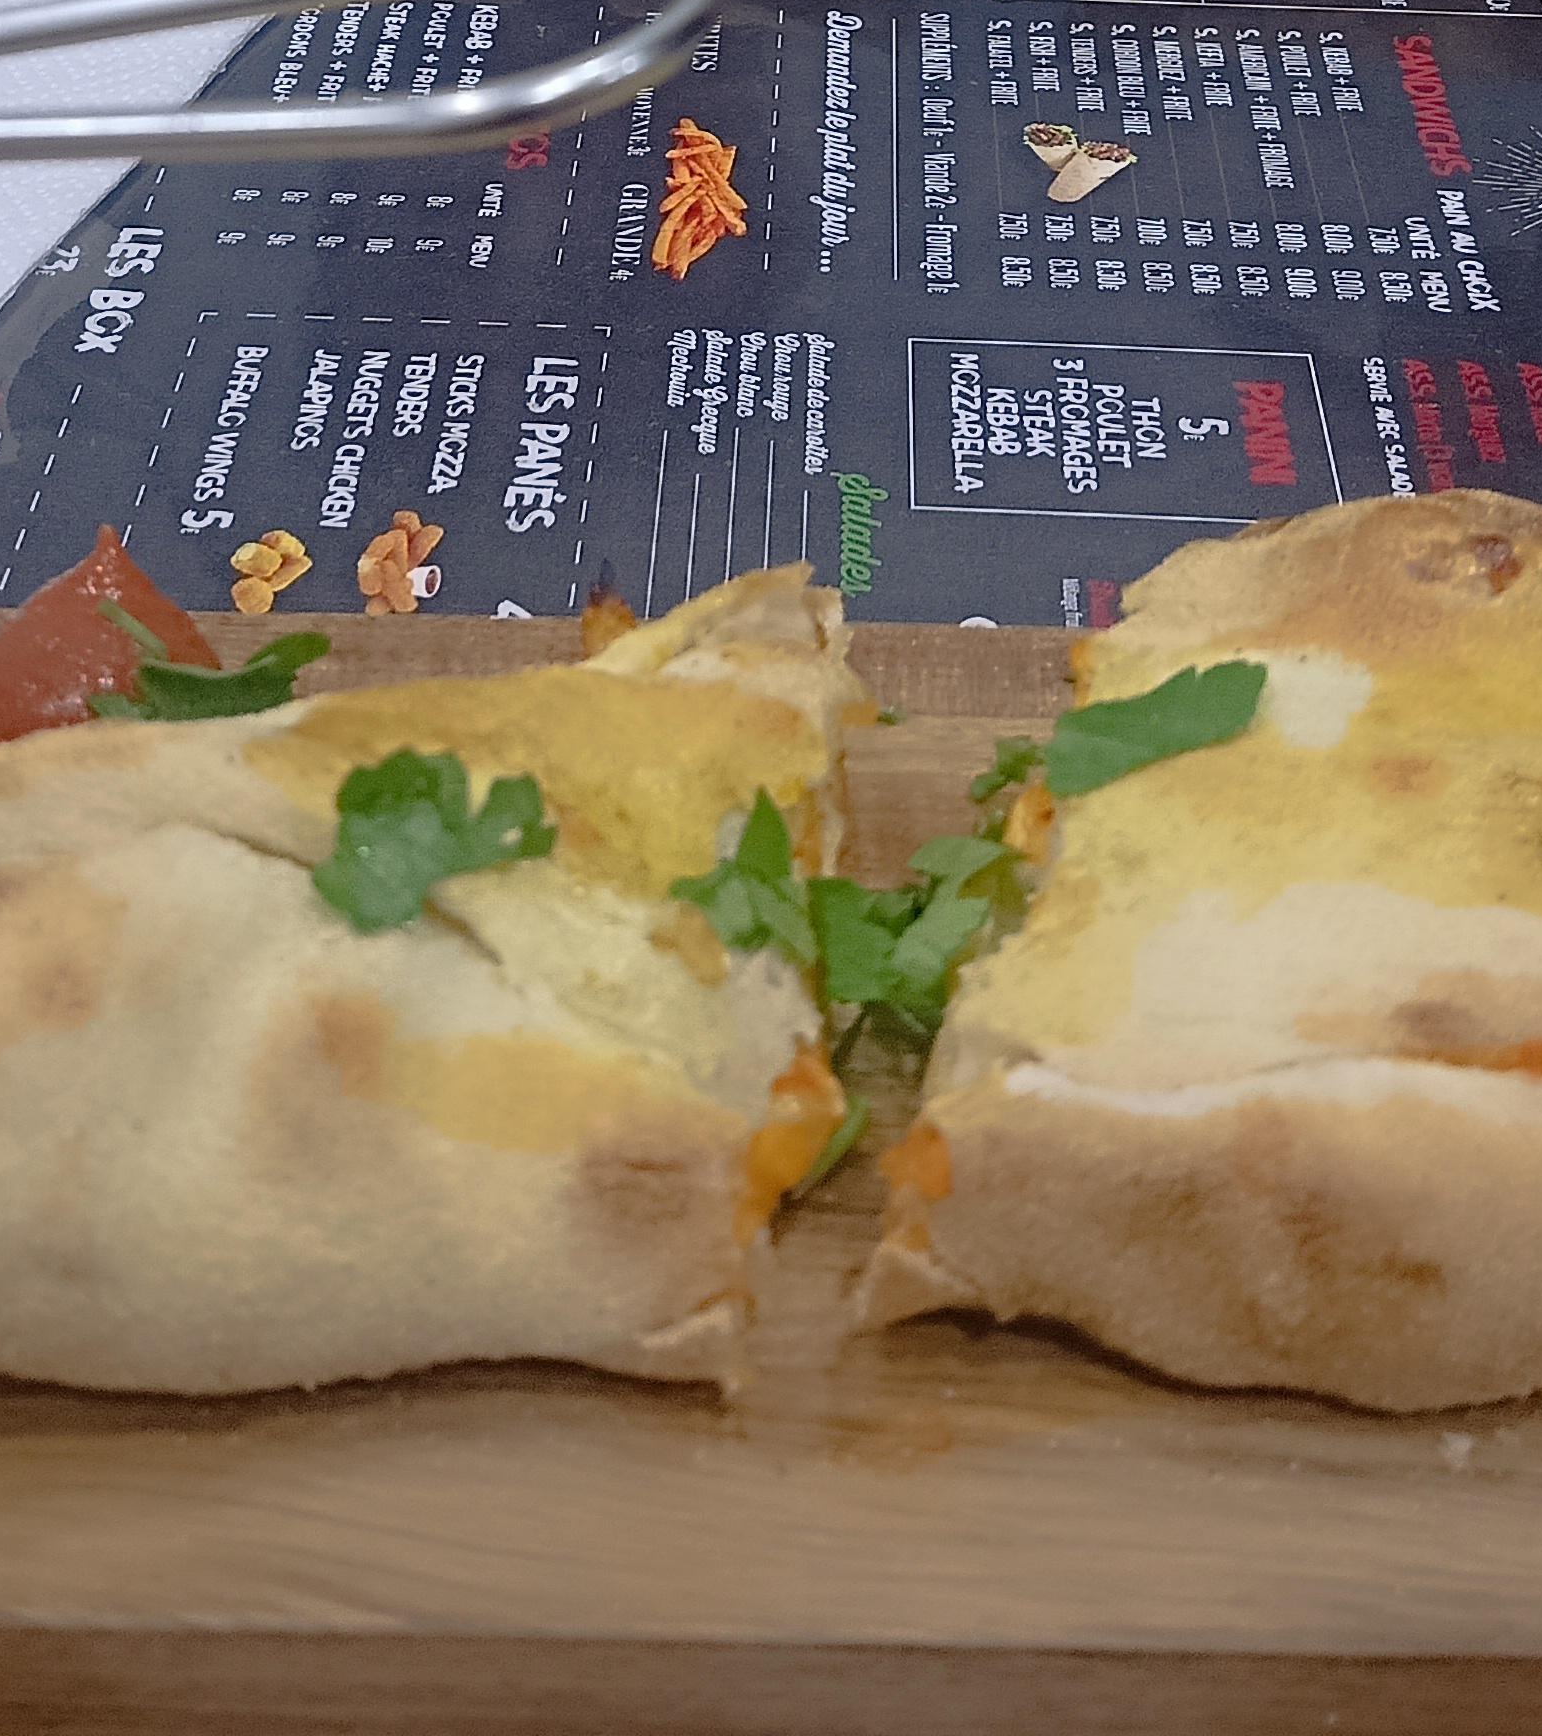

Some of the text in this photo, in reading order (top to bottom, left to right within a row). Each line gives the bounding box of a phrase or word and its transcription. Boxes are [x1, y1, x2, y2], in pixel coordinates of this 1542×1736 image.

[330, 0, 370, 56] TENDERS
[378, 1, 414, 40] STEAK
[463, 3, 499, 50] KEBAB
[363, 1, 454, 254] POULET 10€
[808, 9, 863, 247] Demandez le plat du jour
[918, 11, 958, 279] SUPPLÉMENTS Oeuf Viande 2€ Fromage
[986, 33, 1032, 287] FALAFEL FRITE 7.50€ 8.50€
[1028, 35, 1080, 289] FISH FRITE 7.50€ 8.50€
[1069, 36, 1127, 291] TENDERS FRITE 7.50€ 8.50€
[1110, 38, 1175, 293] CORDON BLEU FRITE 7.00€ 8.50€
[1152, 39, 1222, 295] MERGUEZ FRITE 7.50€ 8.50€
[1194, 41, 1270, 297] KEFTA FRITE 7.50€ 8.50€
[1236, 42, 1318, 299] AMERICAIN FRITE FROMAGE 8.00€ 9.00€
[1278, 44, 1366, 301] POULET FRITE 8.00€ 9.00€
[1320, 45, 1414, 303] KEBAB FRITE 7.50€ 8.50€
[1394, 35, 1501, 312] SANDWICHS PAIN AU CHOIX
[468, 182, 504, 268] UNITÉ MENU
[608, 182, 649, 281] GRANDE 4€
[1403, 215, 1453, 313] UNITÉ MENU
[73, 226, 164, 353] LES BOX
[289, 348, 342, 451] JALAPINOS
[391, 351, 438, 437] TENDERS
[426, 353, 485, 494] STICKS MOZZA
[665, 328, 697, 407] Mechouia
[689, 327, 734, 455] Salade Grecque
[735, 330, 767, 418] Chou blanc
[762, 332, 801, 422] Chou rouge
[801, 331, 835, 475] Salade de carottes
[949, 351, 985, 494] MOZZARELLA
[984, 387, 1022, 456] KEBAB
[1021, 388, 1056, 457] STEAK
[1051, 357, 1098, 494] 3 FROMAGES
[1085, 380, 1132, 469] POULET
[1130, 395, 1167, 459] THON
[1177, 415, 1230, 441] 5€
[1362, 356, 1393, 403] SERVIE
[1373, 405, 1401, 439] AVEC
[179, 345, 269, 534] BUFFALO WINGS 5€
[318, 349, 391, 528] NUGGETS CHICKEN
[502, 356, 579, 533] LES PANÉS
[829, 474, 874, 596] Salades
